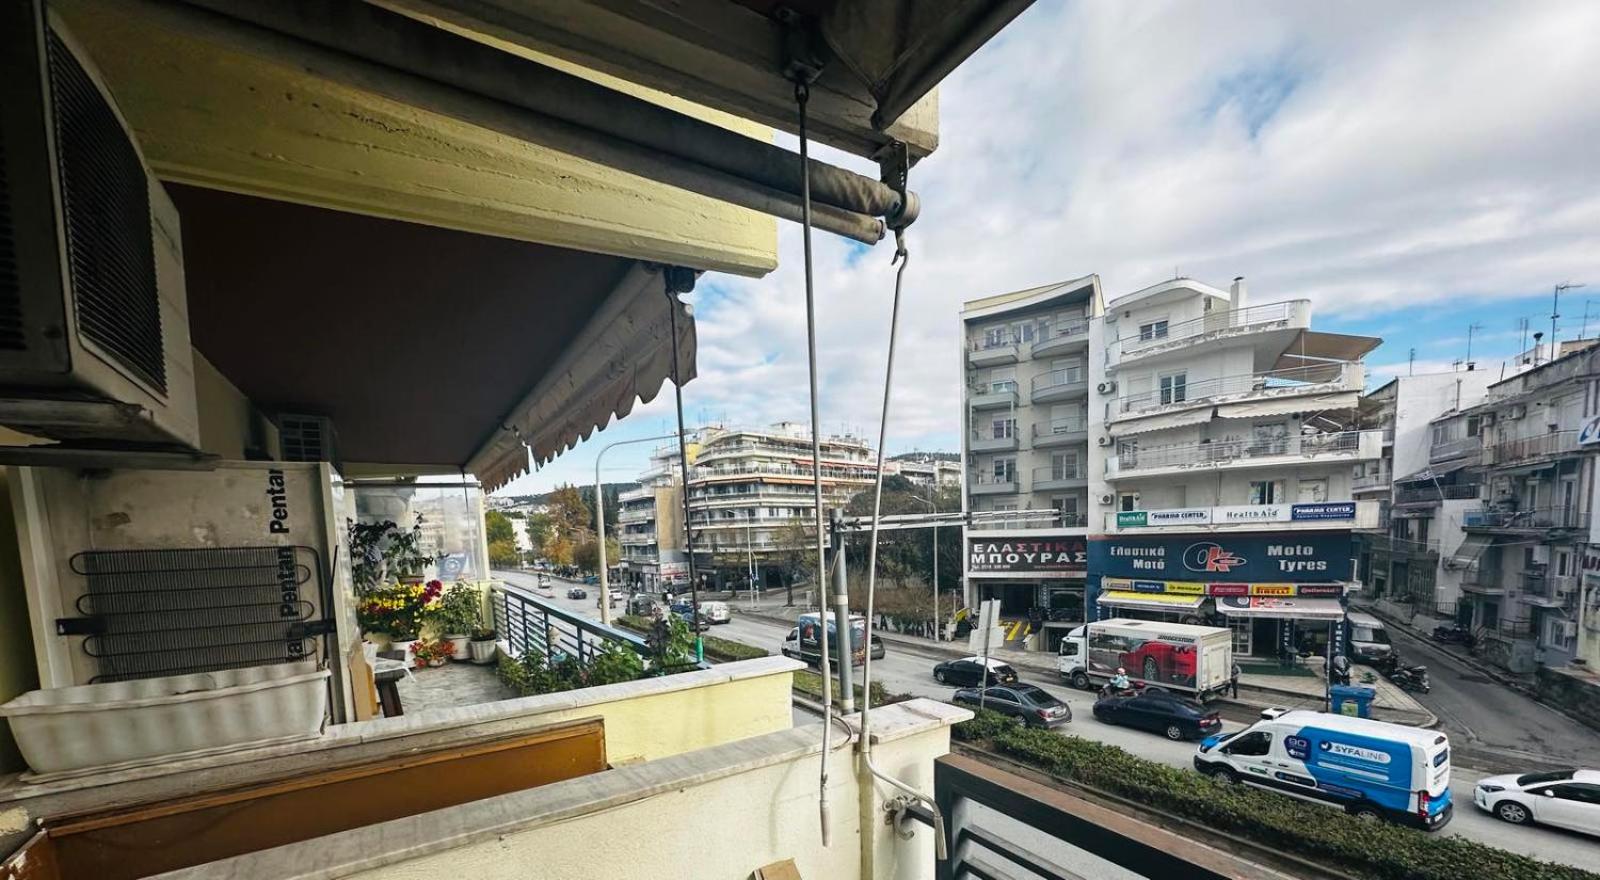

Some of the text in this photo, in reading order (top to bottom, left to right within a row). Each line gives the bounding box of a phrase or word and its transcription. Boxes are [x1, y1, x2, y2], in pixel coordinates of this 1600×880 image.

[1267, 545, 1313, 557] Moto
[971, 552, 1087, 564] ΜΠΟΥΡΑΣ
[1278, 559, 1327, 572] Tyres
